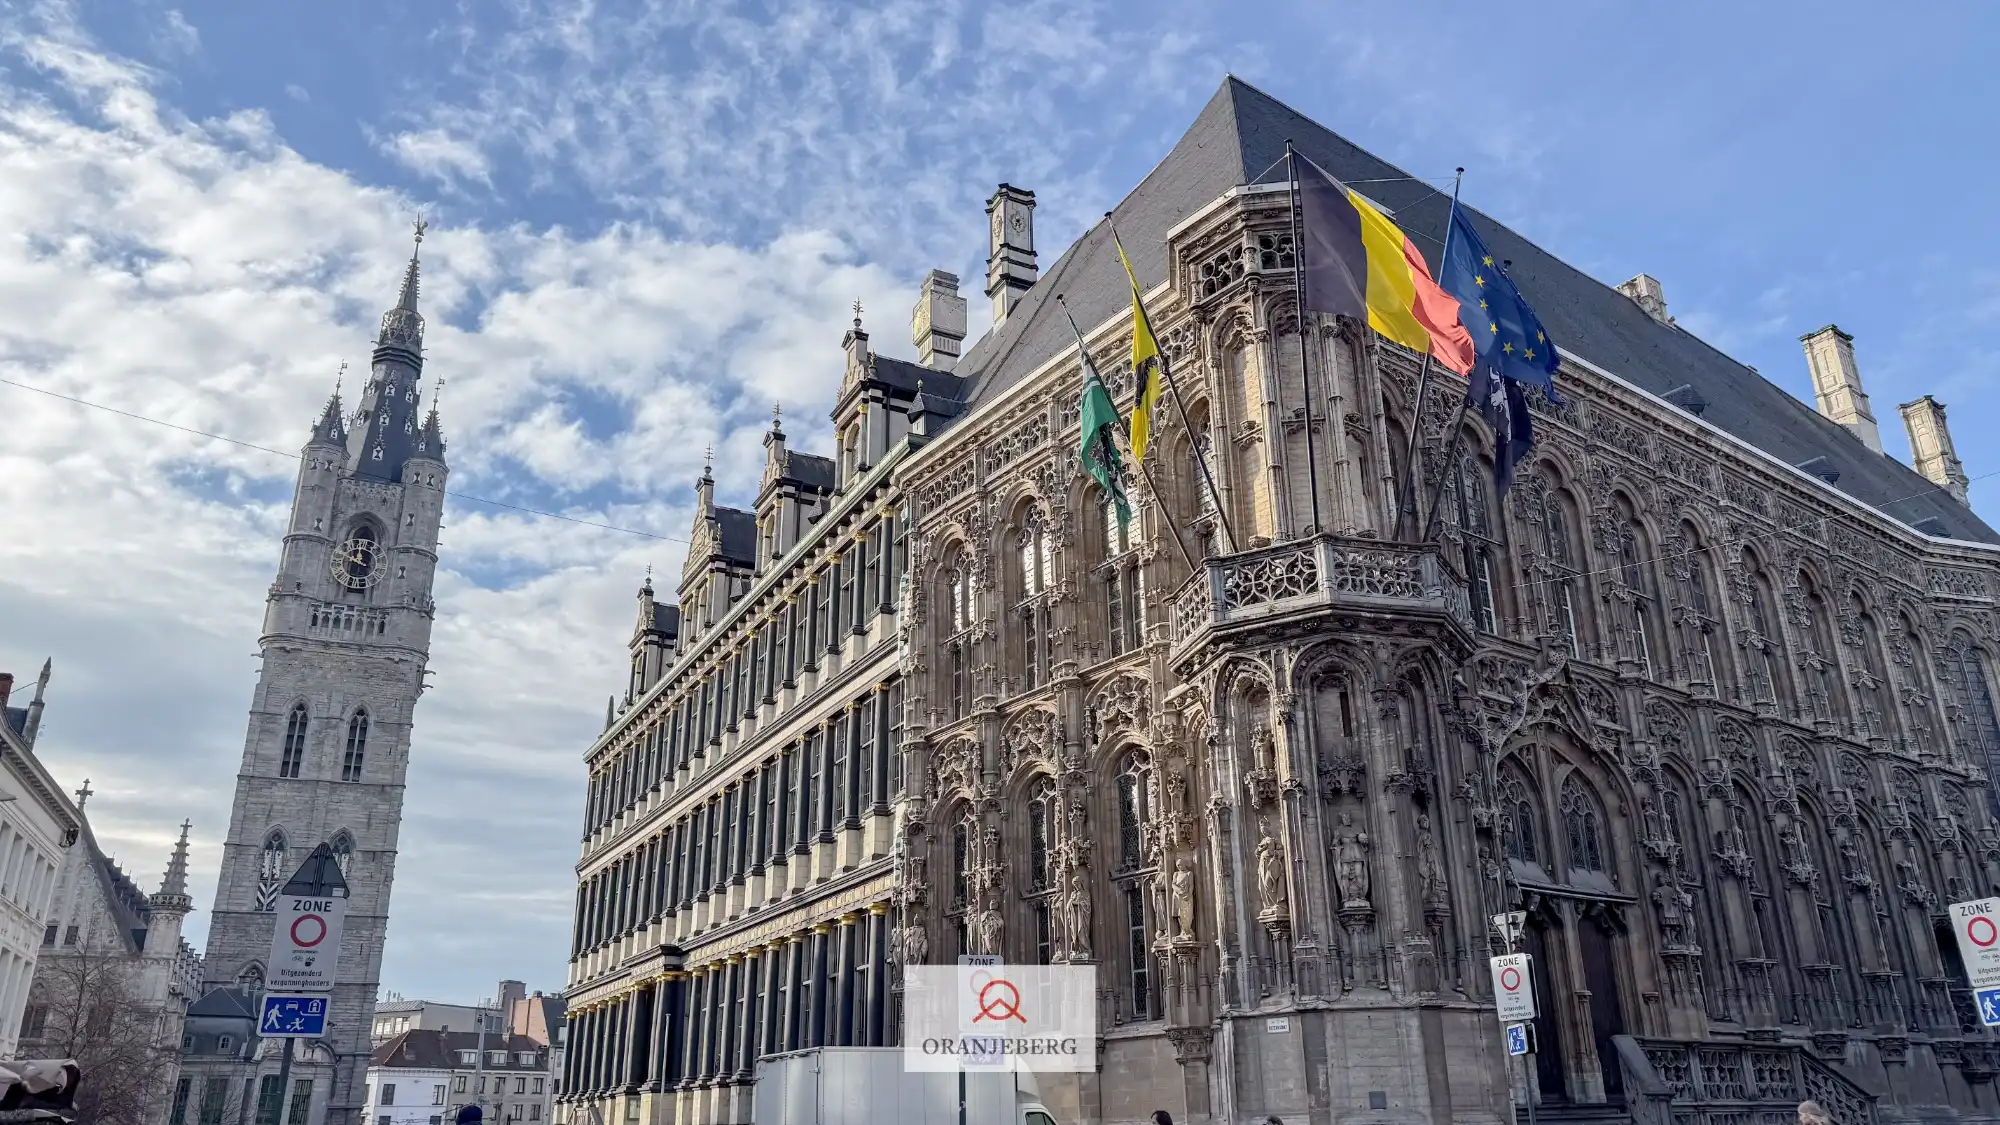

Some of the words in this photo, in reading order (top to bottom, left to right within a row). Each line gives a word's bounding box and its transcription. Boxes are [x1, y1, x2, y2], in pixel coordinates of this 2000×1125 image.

[292, 899, 333, 912] ZONE
[1960, 903, 1992, 916] ZONE
[968, 958, 995, 966] ZONE
[1498, 957, 1519, 967] ZONE
[281, 968, 323, 978] Uitgezonderd
